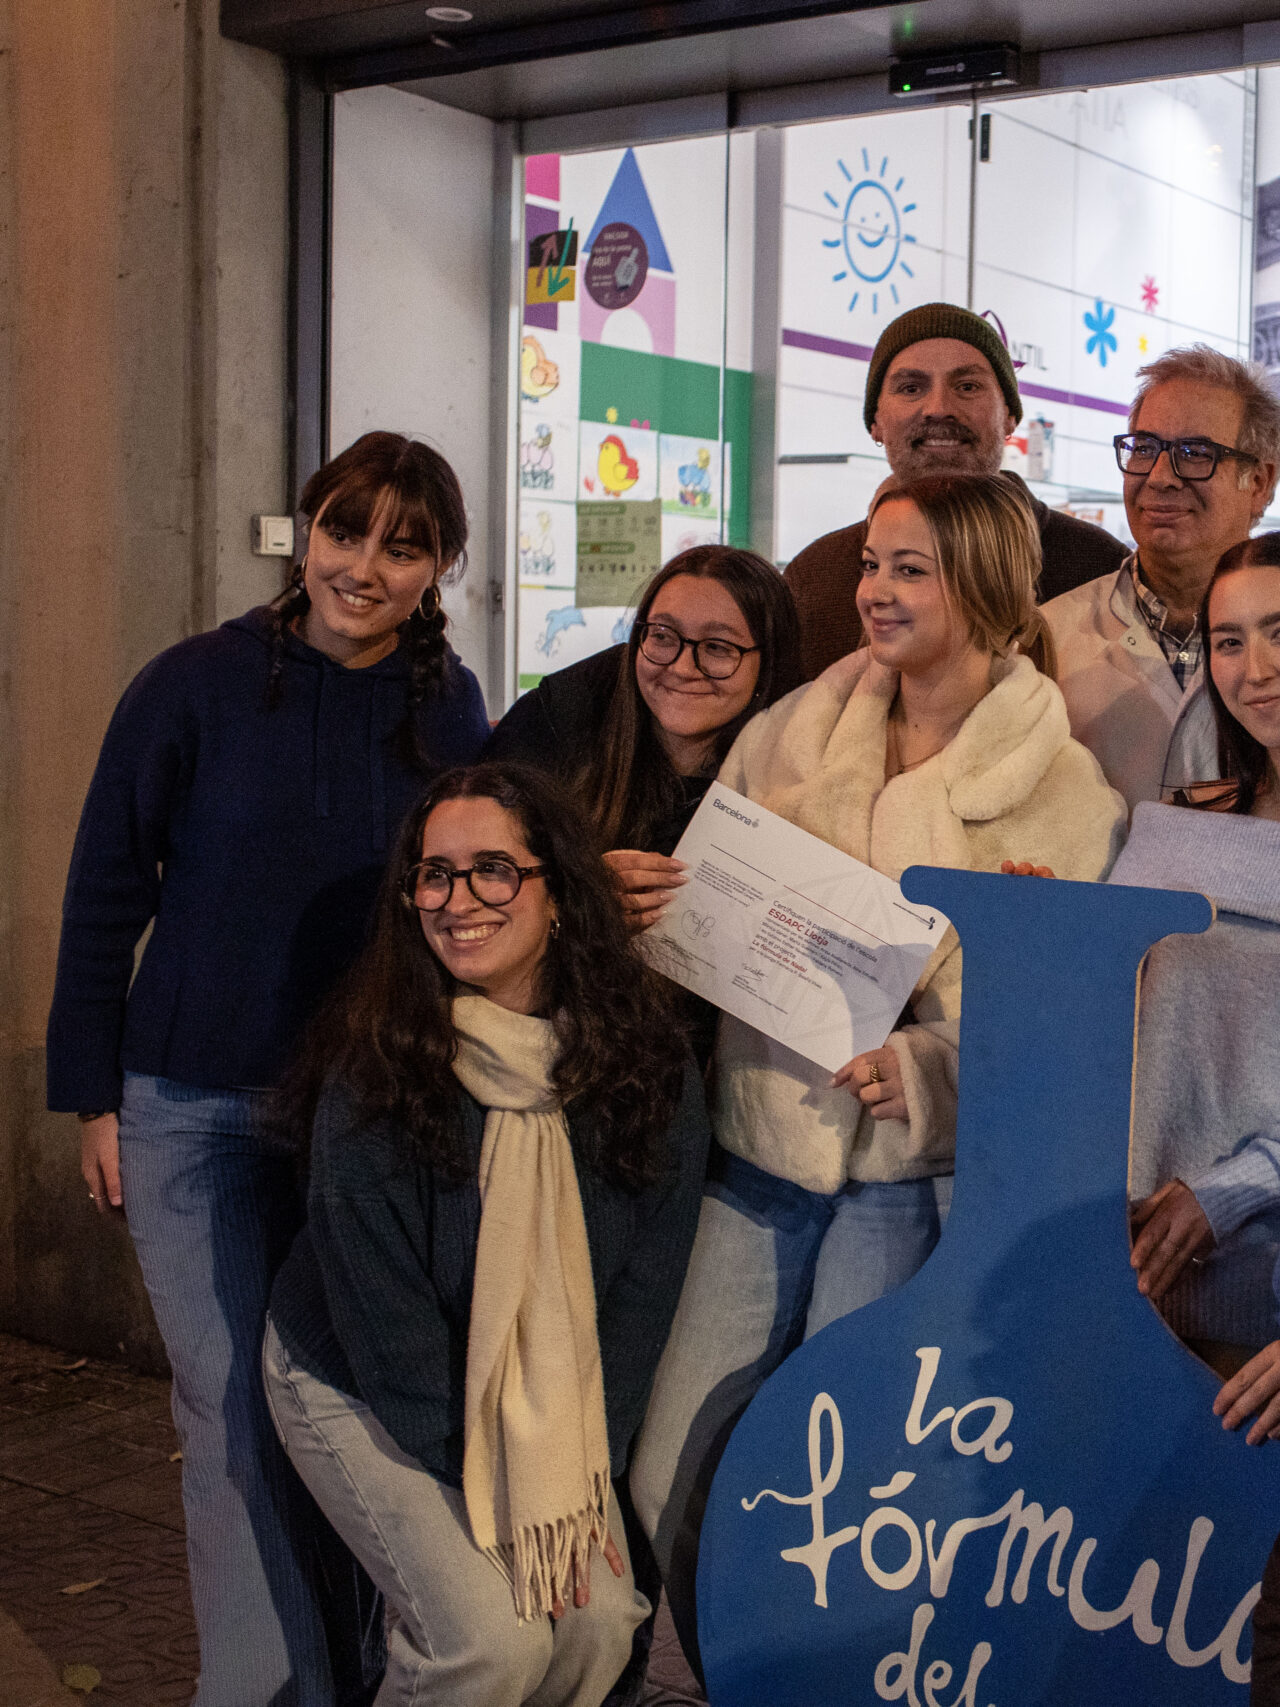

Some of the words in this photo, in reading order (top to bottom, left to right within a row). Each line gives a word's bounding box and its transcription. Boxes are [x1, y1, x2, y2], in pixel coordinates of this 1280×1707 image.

[713, 798, 752, 825] Barcelona
[773, 900, 805, 921] Certifiquen
[768, 908, 803, 931] ESDAPC
[804, 928, 829, 947] Llotja
[774, 944, 795, 958] projecte
